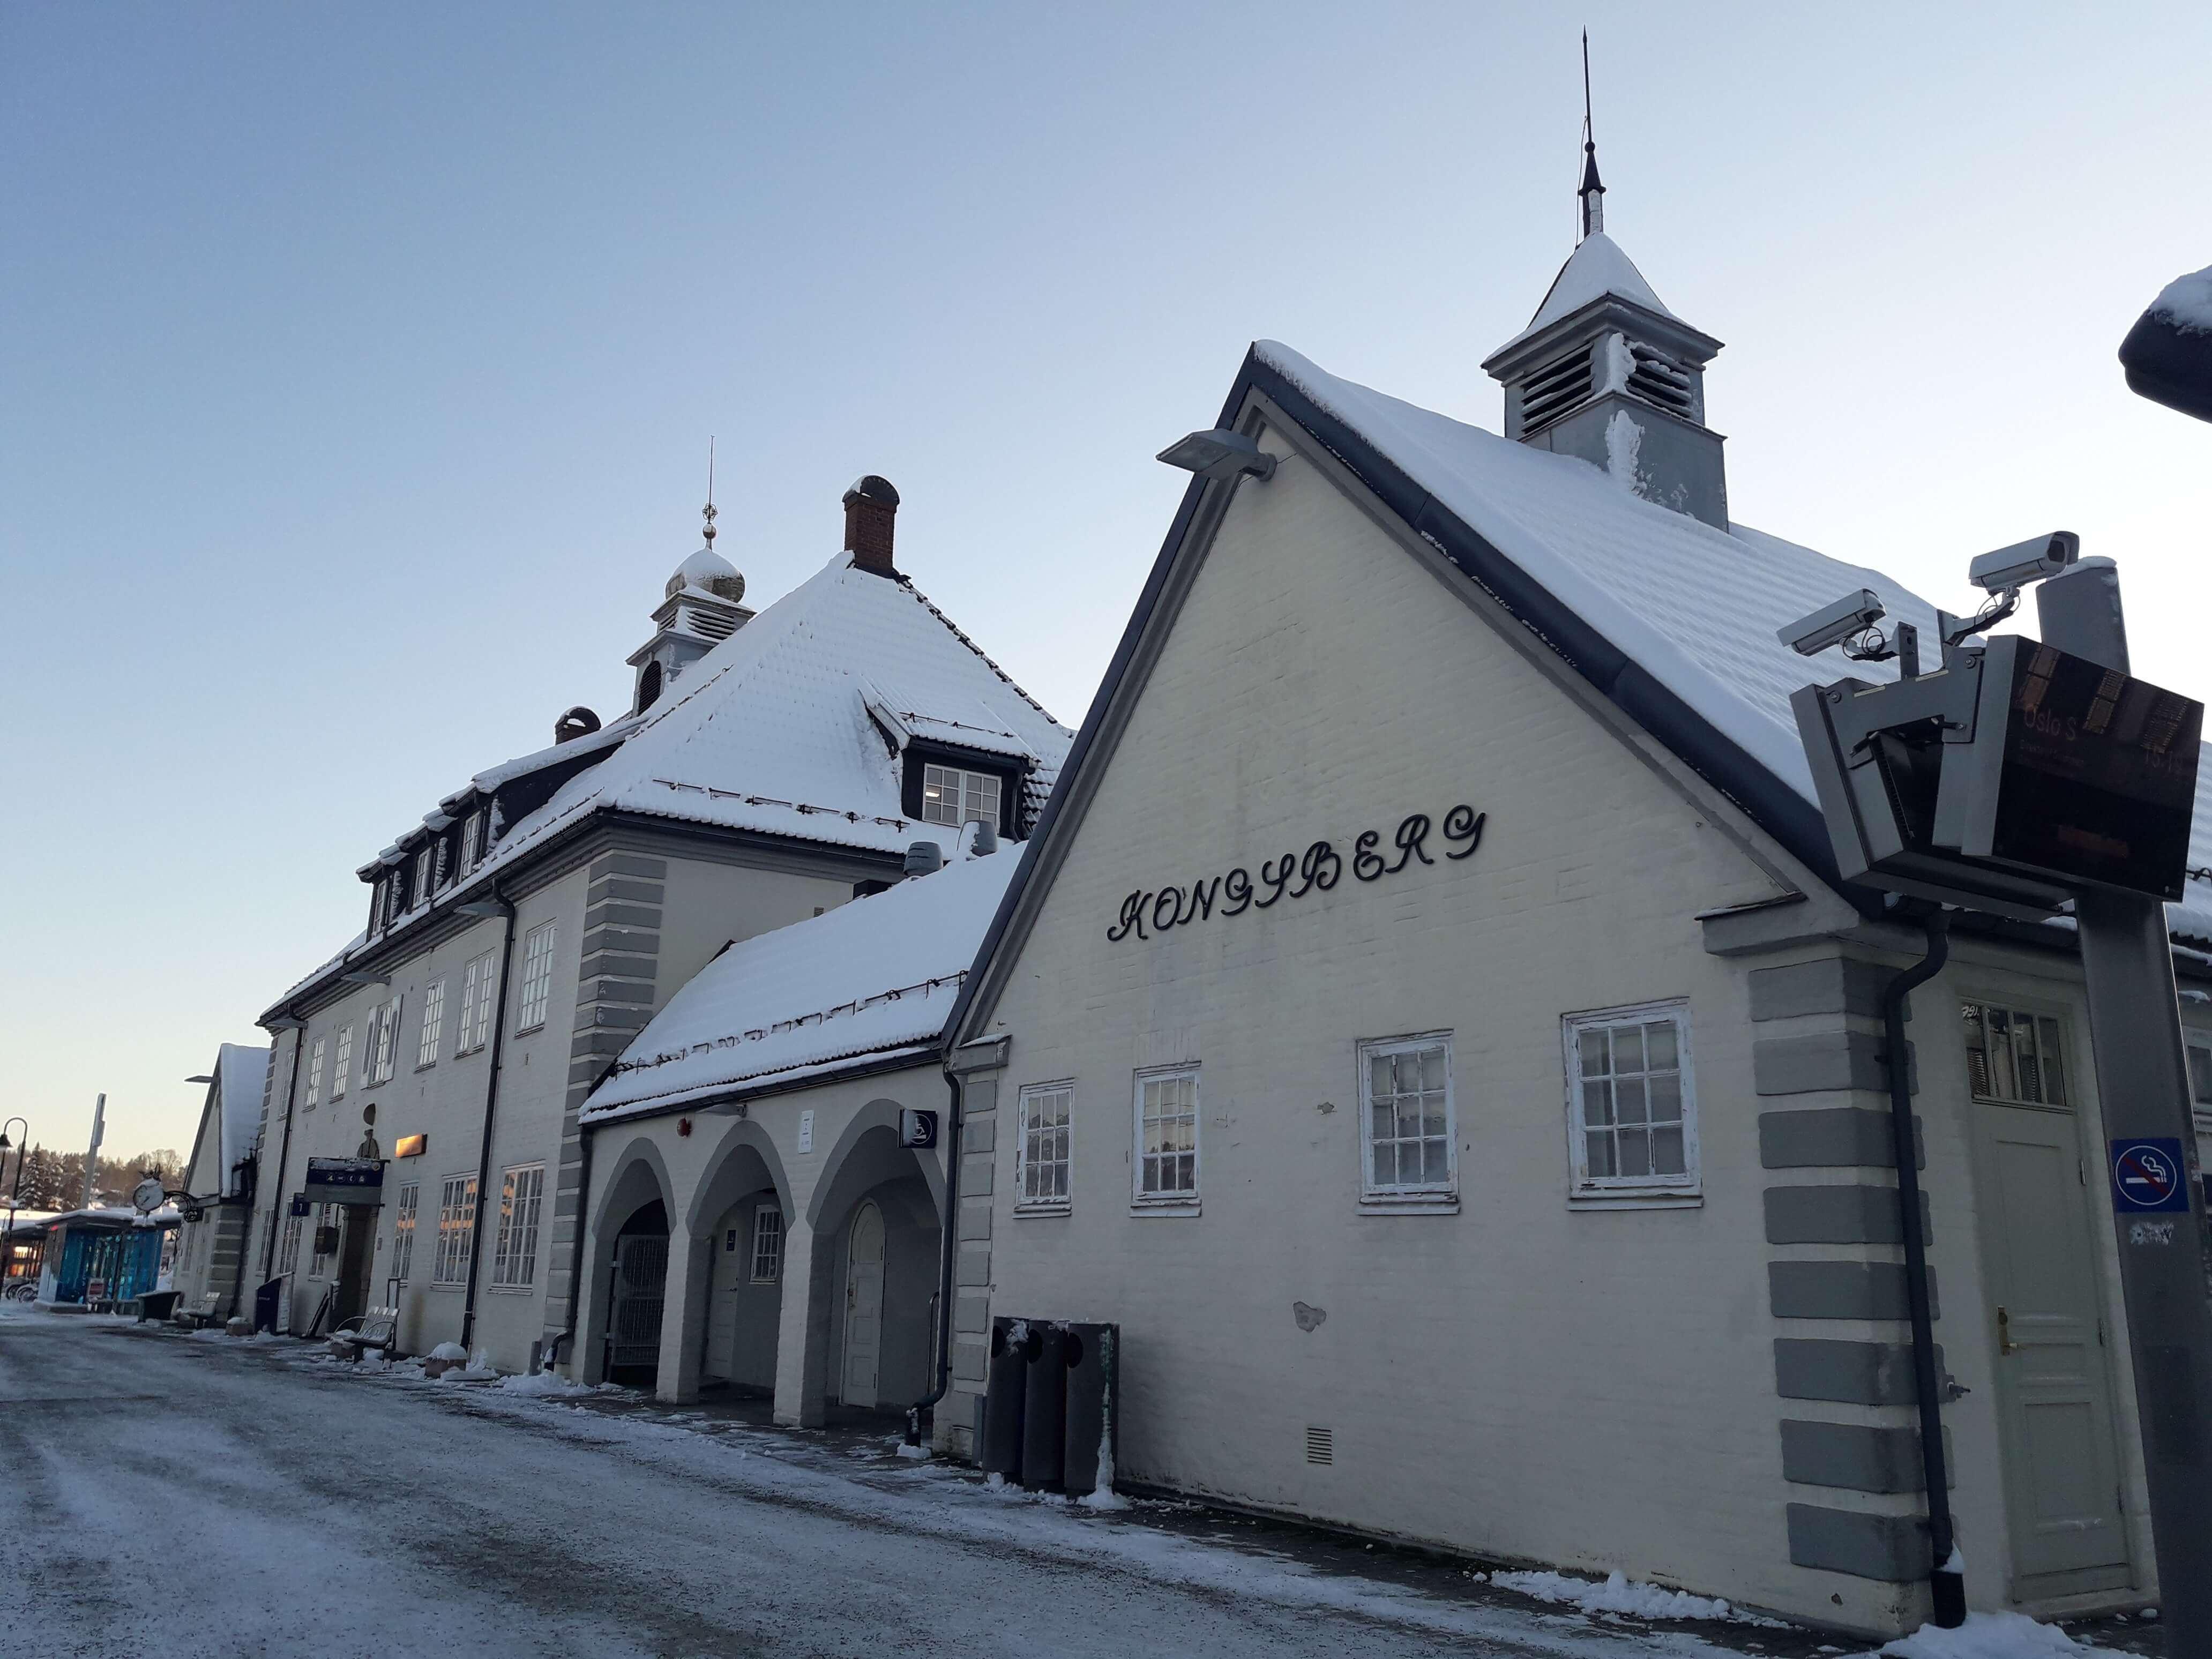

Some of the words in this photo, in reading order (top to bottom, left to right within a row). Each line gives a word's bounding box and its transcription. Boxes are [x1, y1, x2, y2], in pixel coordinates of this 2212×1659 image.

[2024, 706, 2061, 736] Oslo
[2065, 716, 2076, 742] S
[1106, 804, 1487, 942] KONGSBERG
[298, 1202, 303, 1213] 1
